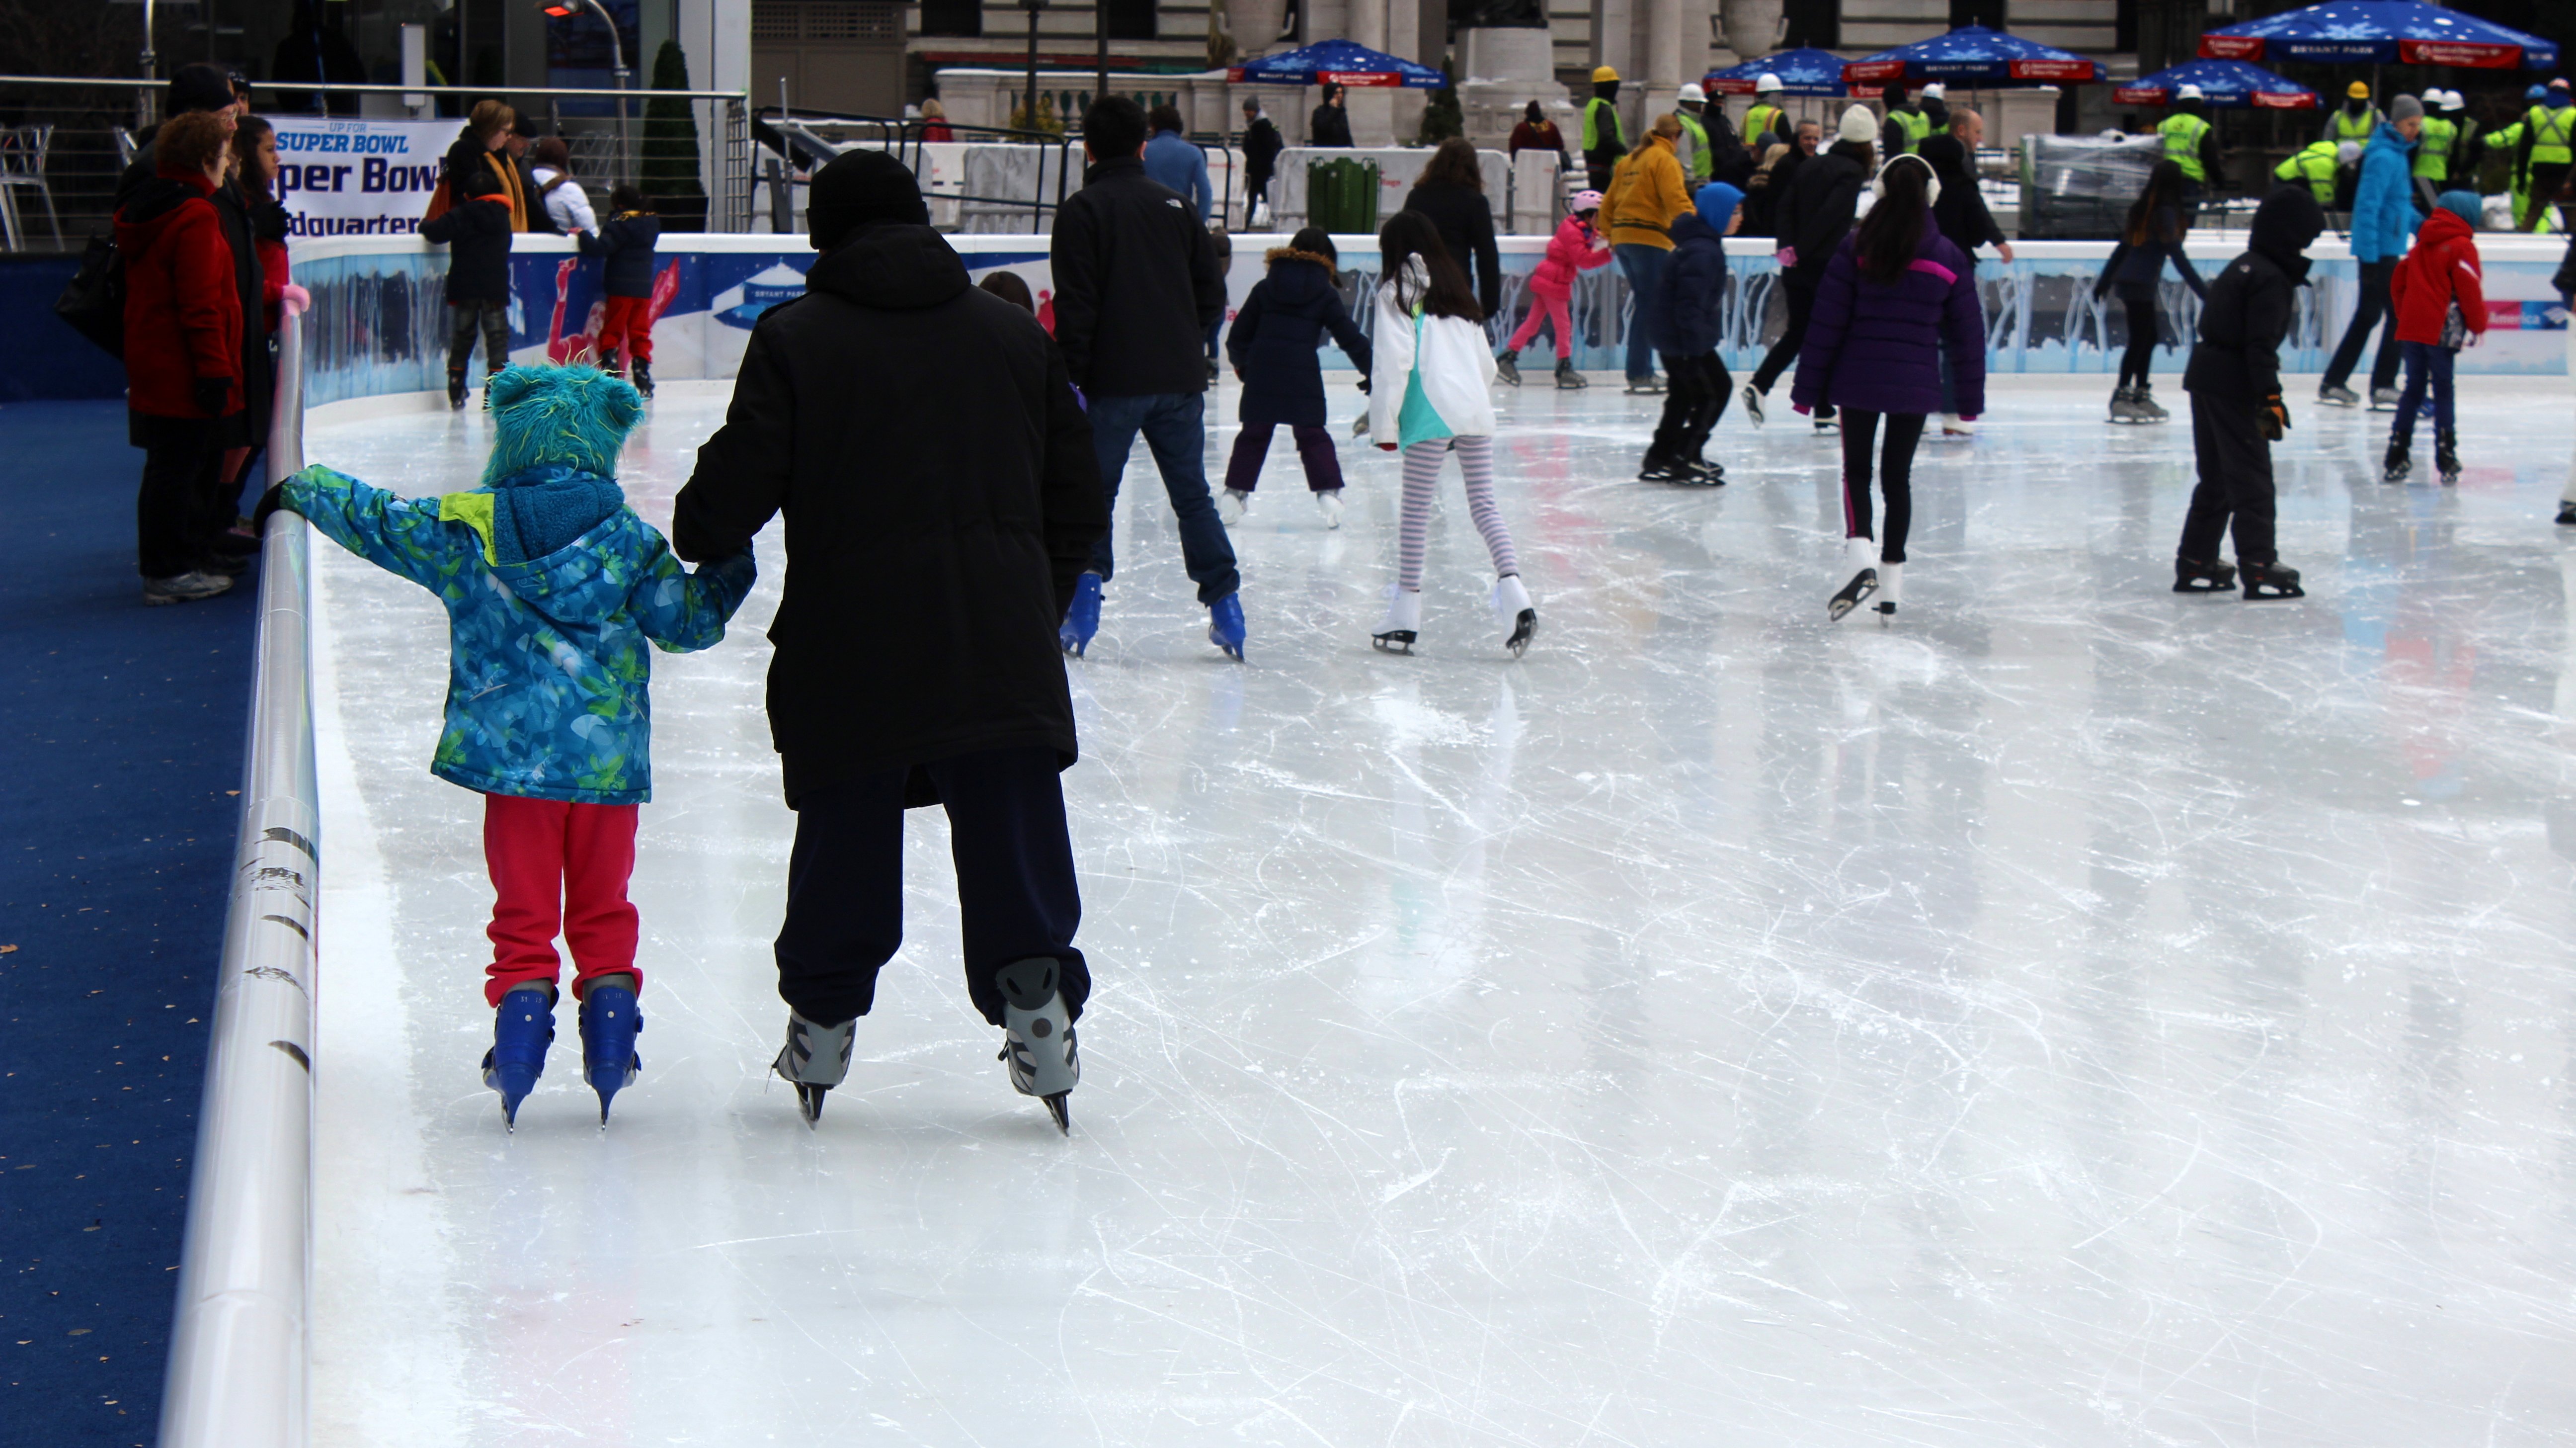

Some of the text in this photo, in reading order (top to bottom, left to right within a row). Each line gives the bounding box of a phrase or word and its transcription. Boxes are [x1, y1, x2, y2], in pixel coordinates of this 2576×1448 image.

[2342, 45, 2374, 54] PARK
[329, 122, 367, 133] UP FOR
[275, 132, 409, 154] SUPER BOWL
[270, 164, 352, 200] per
[290, 211, 420, 237] dquarter
[2488, 310, 2541, 325] America
